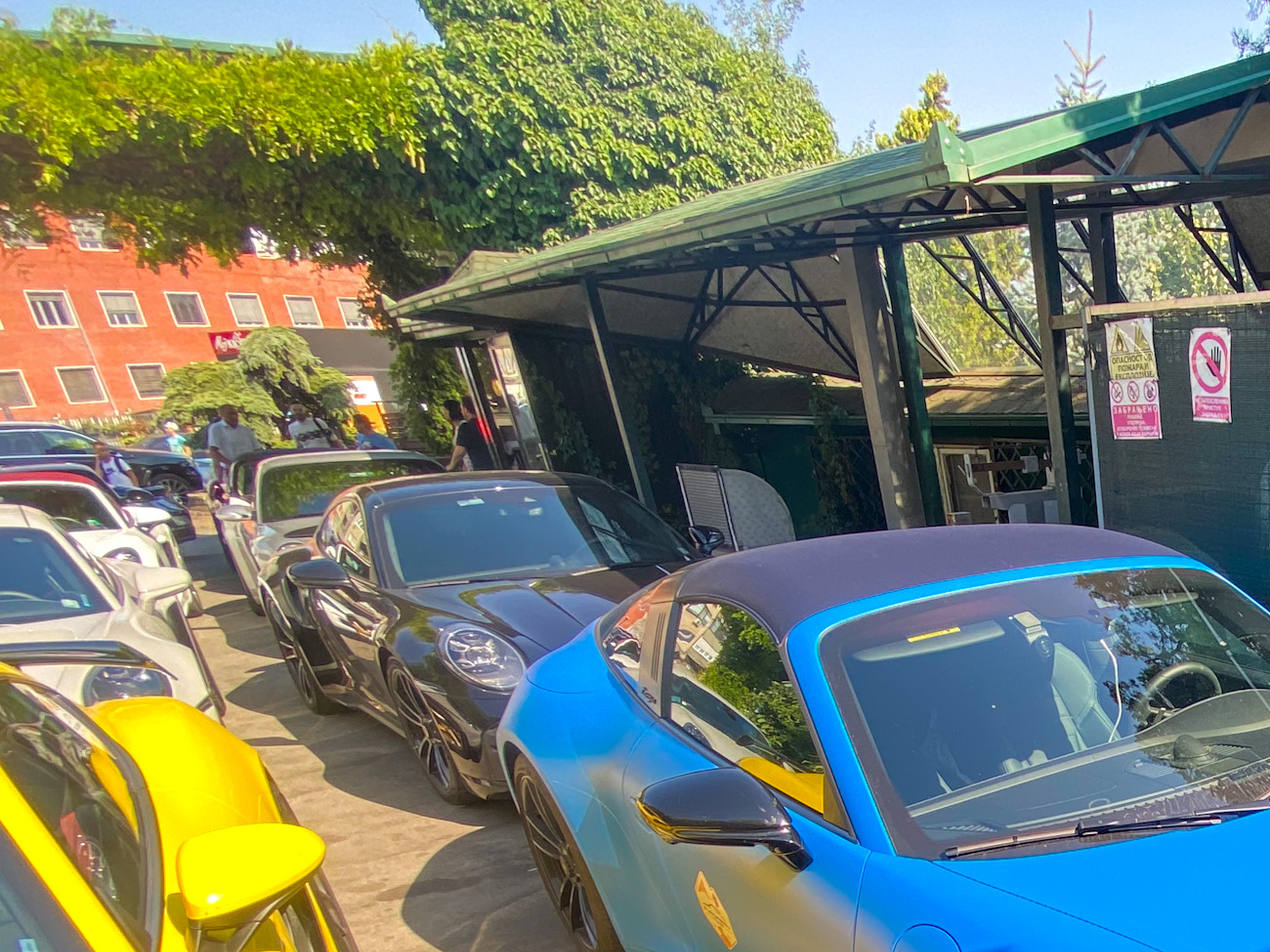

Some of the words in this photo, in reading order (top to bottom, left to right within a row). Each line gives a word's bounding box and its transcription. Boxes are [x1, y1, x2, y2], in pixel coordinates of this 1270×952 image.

[1112, 355, 1142, 365] ОПАСНОСТ
[1118, 363, 1143, 372] ПОЖАРА
[1113, 405, 1158, 415] ЗАБРАЊЕНО
